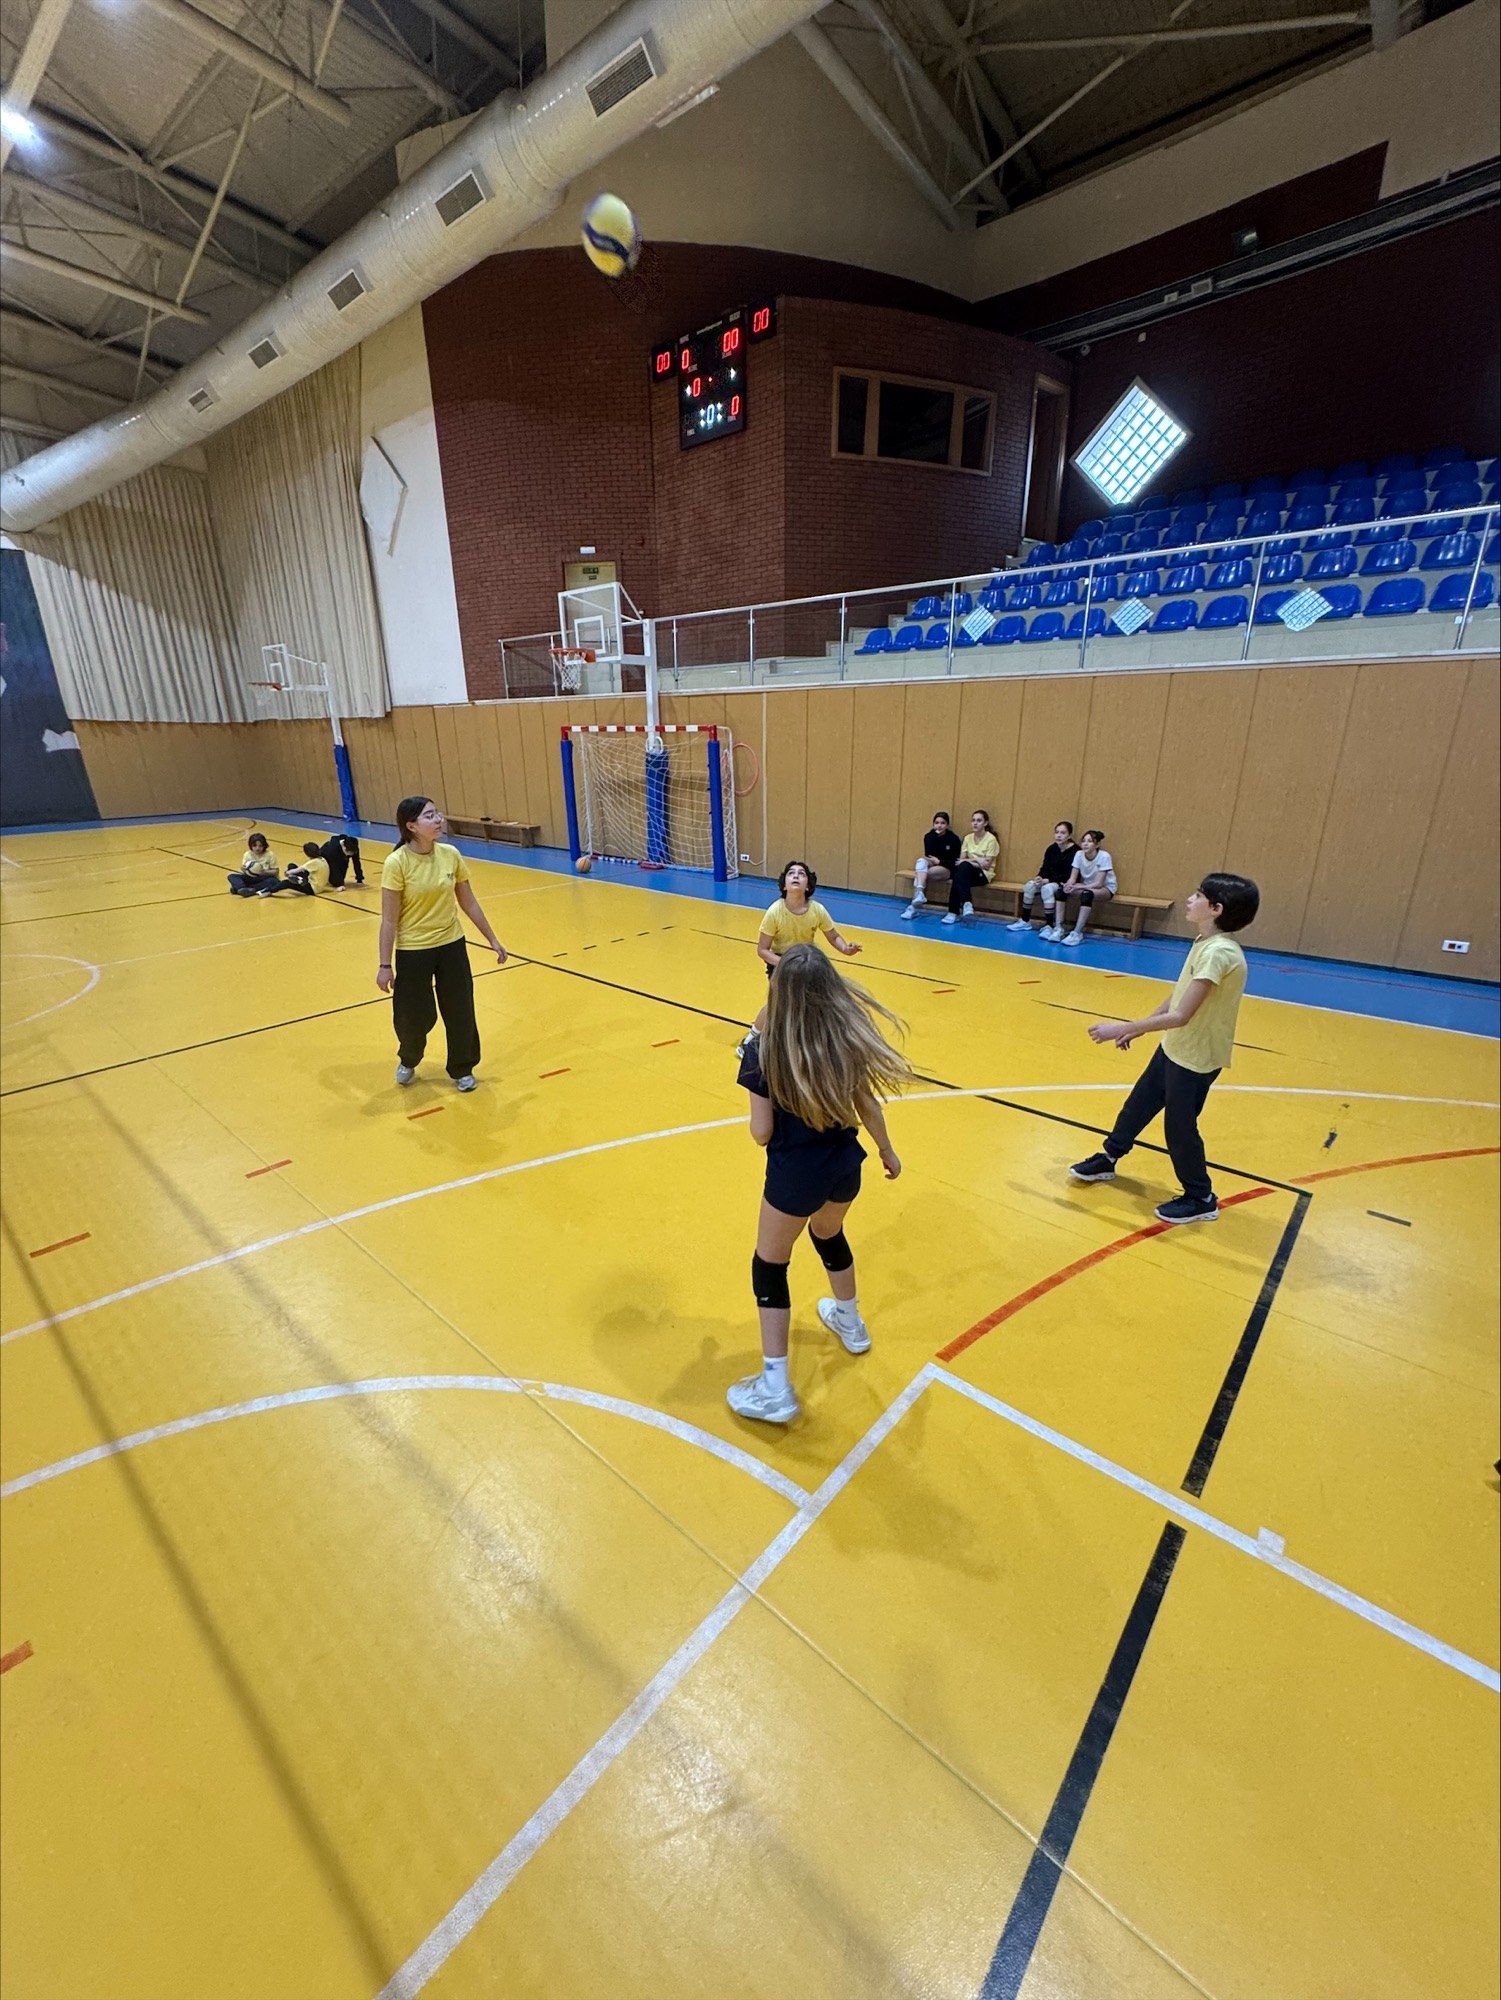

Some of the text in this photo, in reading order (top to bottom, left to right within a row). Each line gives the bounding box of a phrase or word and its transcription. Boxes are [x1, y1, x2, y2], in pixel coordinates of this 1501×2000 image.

[753, 307, 770, 333] 00
[723, 327, 739, 353] 00
[656, 351, 671, 373] 00
[681, 348, 690, 370] 0
[706, 403, 715, 424] 0
[731, 395, 740, 416] 0
